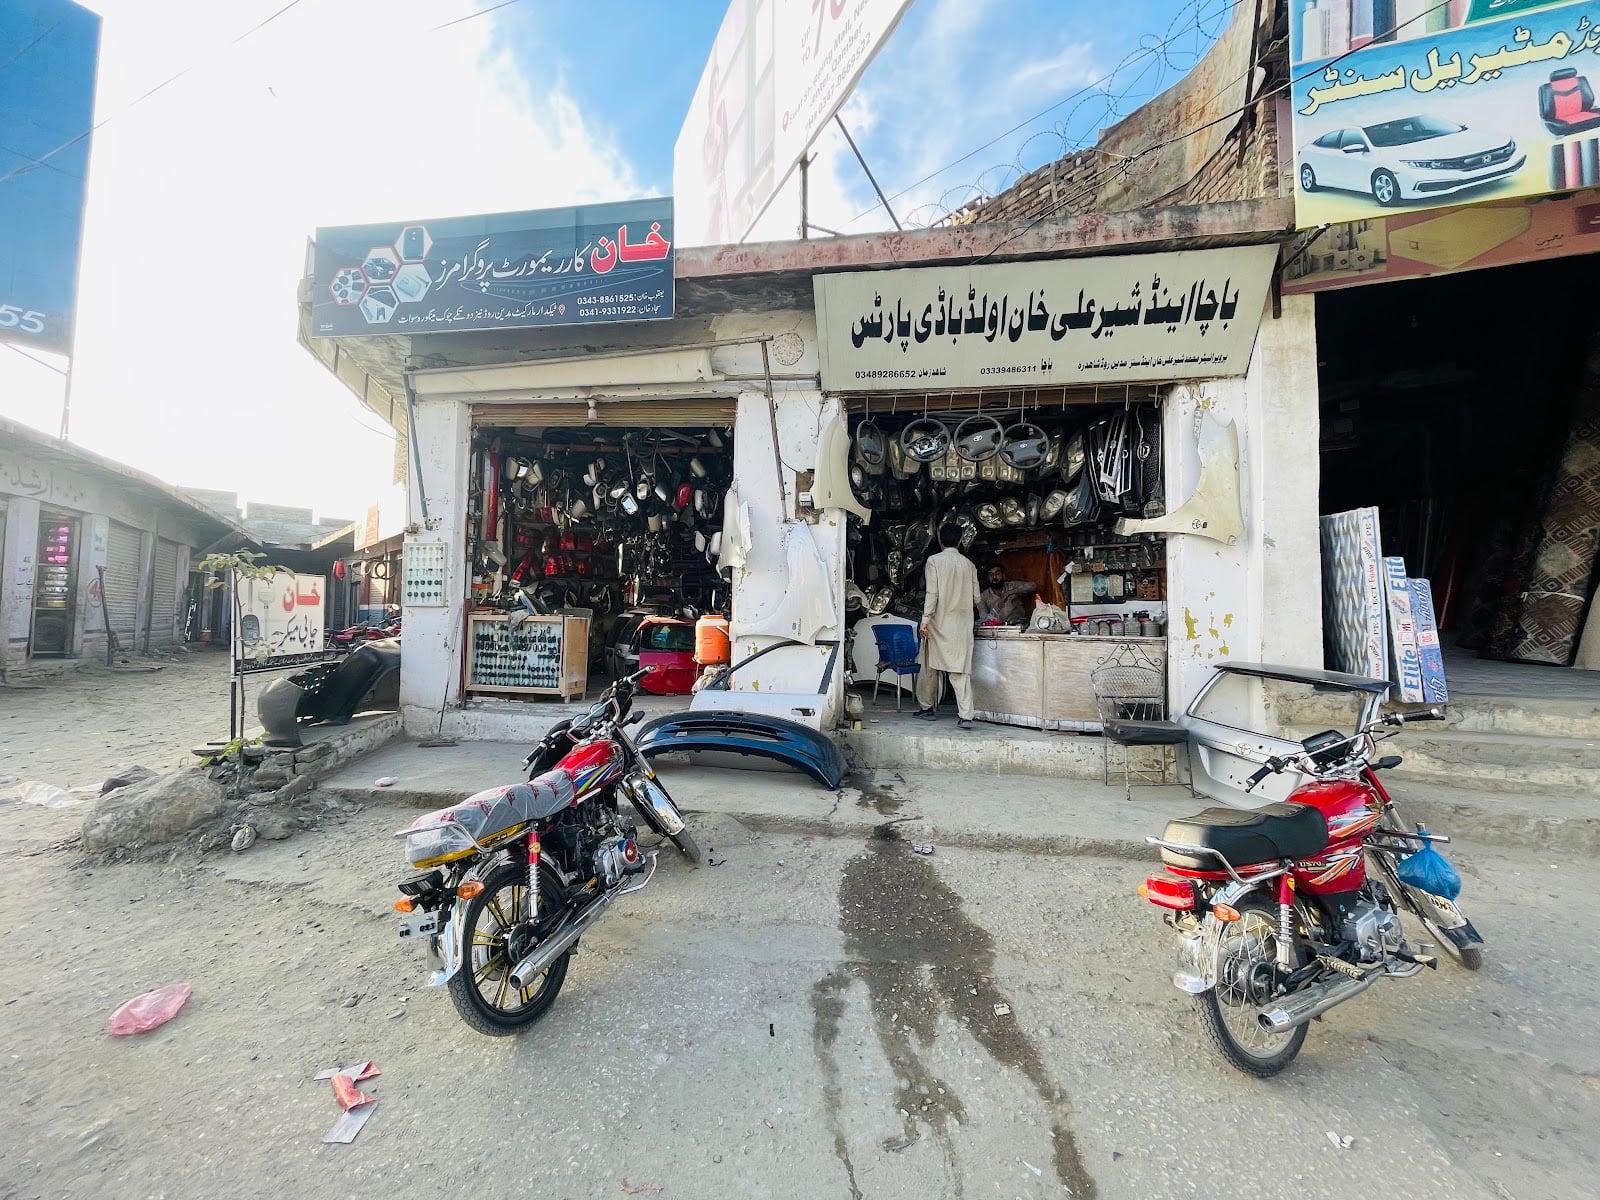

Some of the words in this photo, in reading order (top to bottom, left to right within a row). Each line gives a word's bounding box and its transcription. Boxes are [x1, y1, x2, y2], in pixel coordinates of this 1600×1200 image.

[1410, 25, 1574, 93] مٹیریل
[1298, 64, 1406, 116] سنٹر
[590, 221, 671, 275] خان
[851, 290, 912, 354] پارٹس
[914, 284, 963, 345] باڈی
[1008, 288, 1051, 343] خان
[1050, 287, 1096, 342] علی
[1091, 281, 1143, 340] شیر
[1143, 272, 1198, 334] اینڈ
[1194, 276, 1240, 337] باچا
[855, 370, 916, 379] 03489286652
[282, 581, 321, 613] خان
[1401, 649, 1420, 690] Elite
